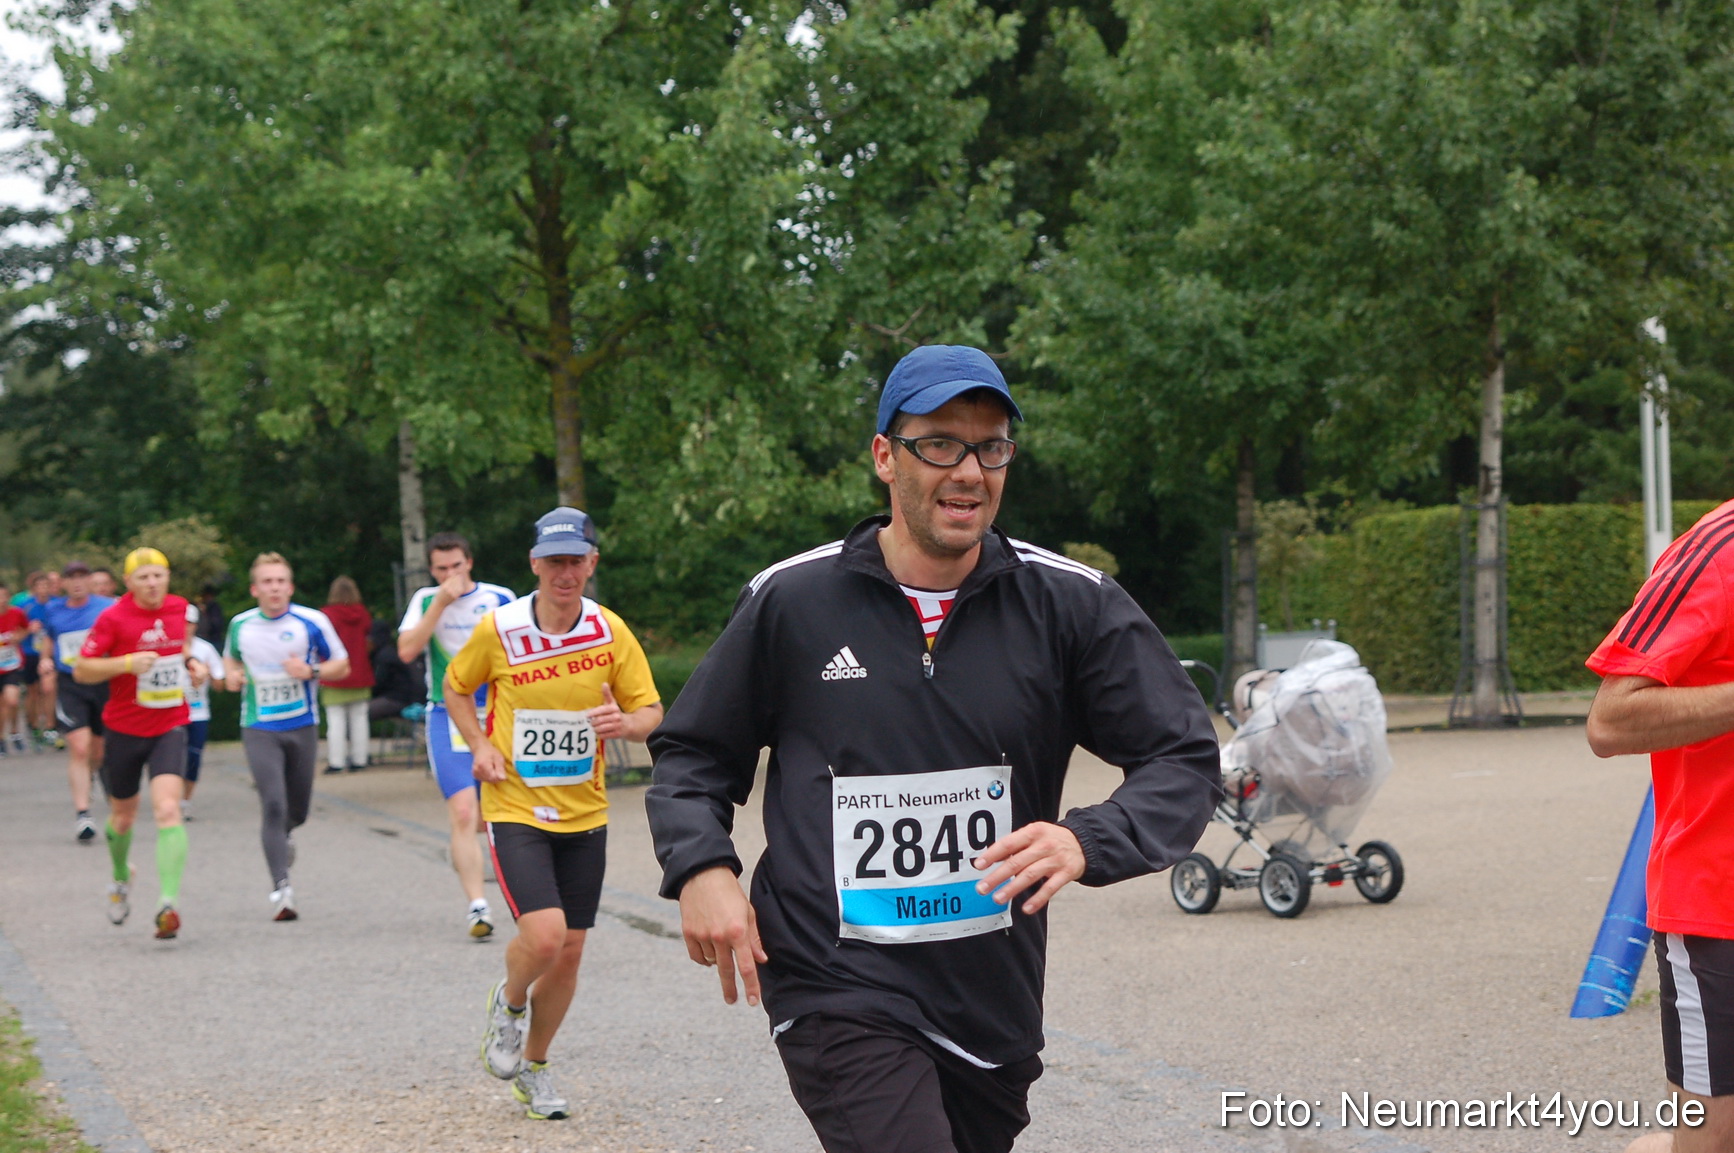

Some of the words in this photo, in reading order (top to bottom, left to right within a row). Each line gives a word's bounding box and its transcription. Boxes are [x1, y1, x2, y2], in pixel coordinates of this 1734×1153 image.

[512, 664, 560, 687] MAX
[821, 667, 868, 681] adidas
[523, 727, 589, 756] 2845
[533, 763, 579, 775] Andreas
[837, 794, 894, 810] PARTL
[899, 787, 981, 808] Neumarkt
[853, 809, 996, 879] 2849
[842, 876, 850, 888] B
[896, 893, 962, 920] Mario
